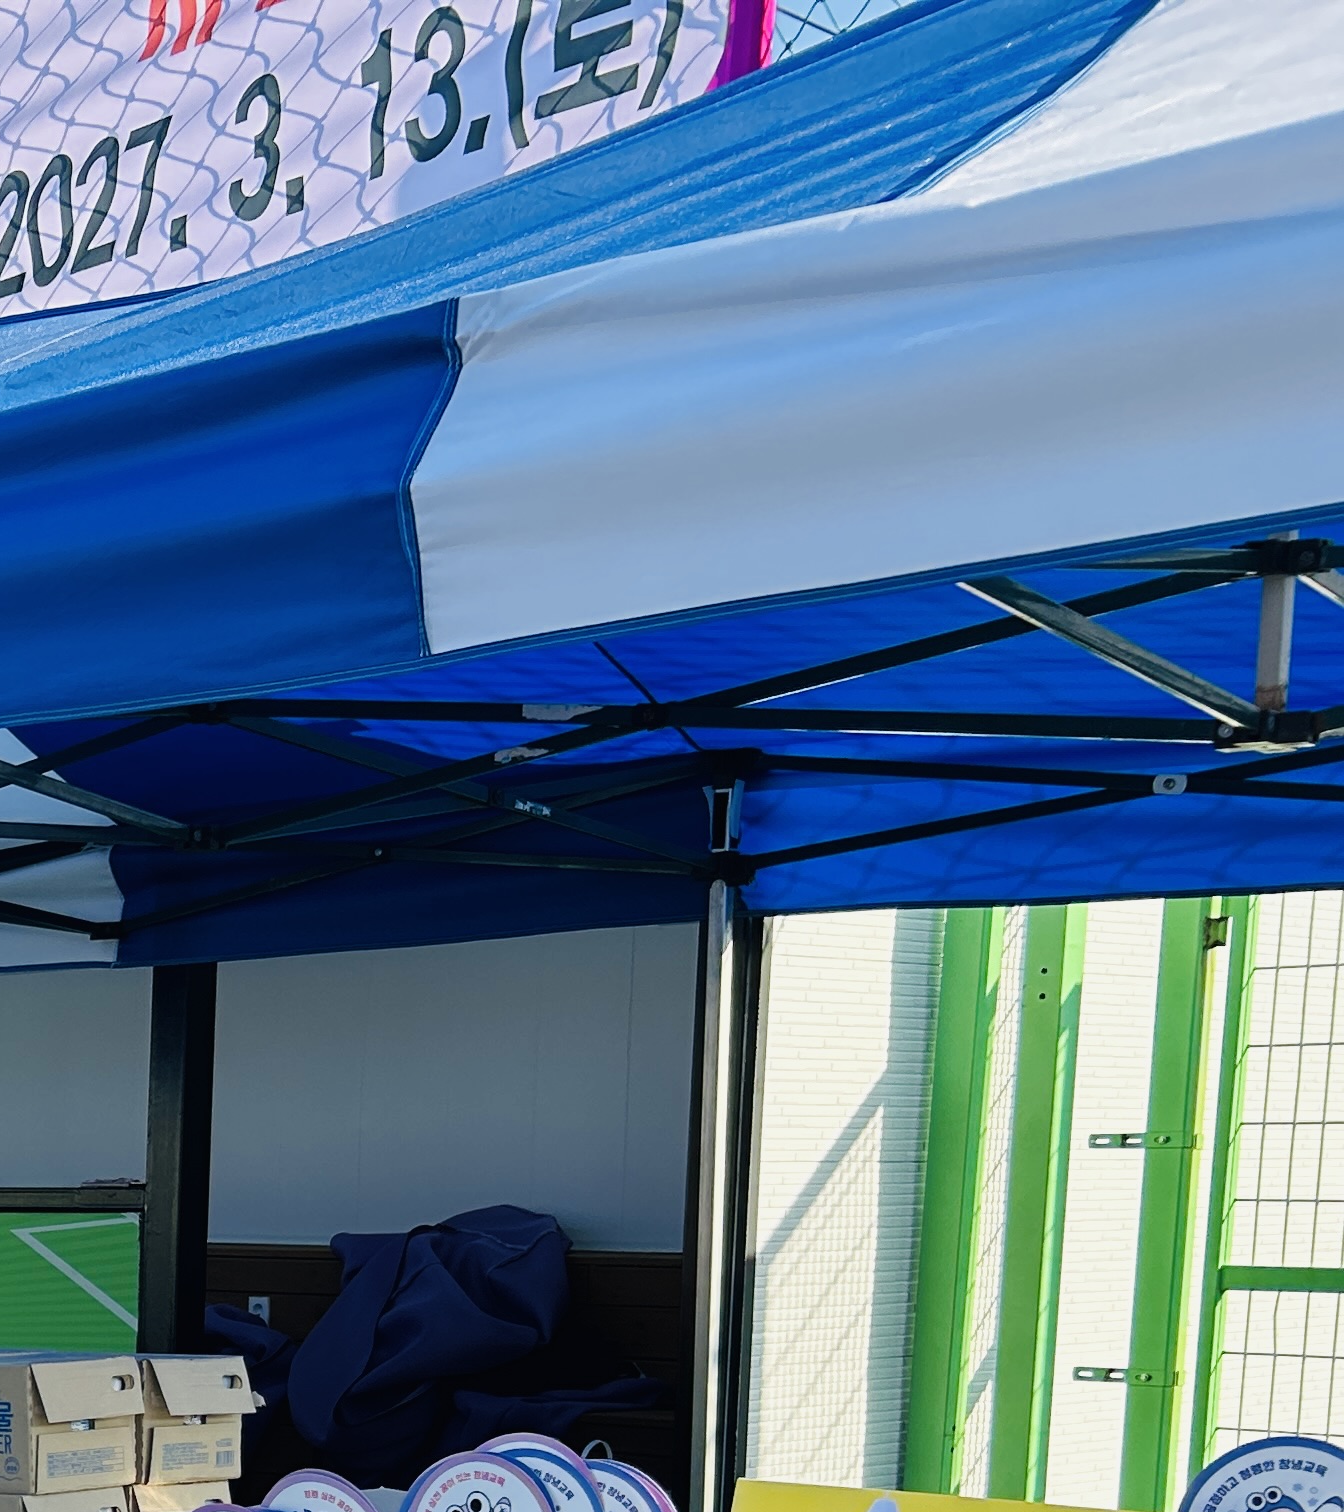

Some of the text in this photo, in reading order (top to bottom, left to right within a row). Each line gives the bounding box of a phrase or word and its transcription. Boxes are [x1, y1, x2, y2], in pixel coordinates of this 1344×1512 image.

[227, 73, 305, 222] 3.
[1238, 1459, 1275, 1481] 청렴한
[1278, 1458, 1329, 1479] 창녕교육
